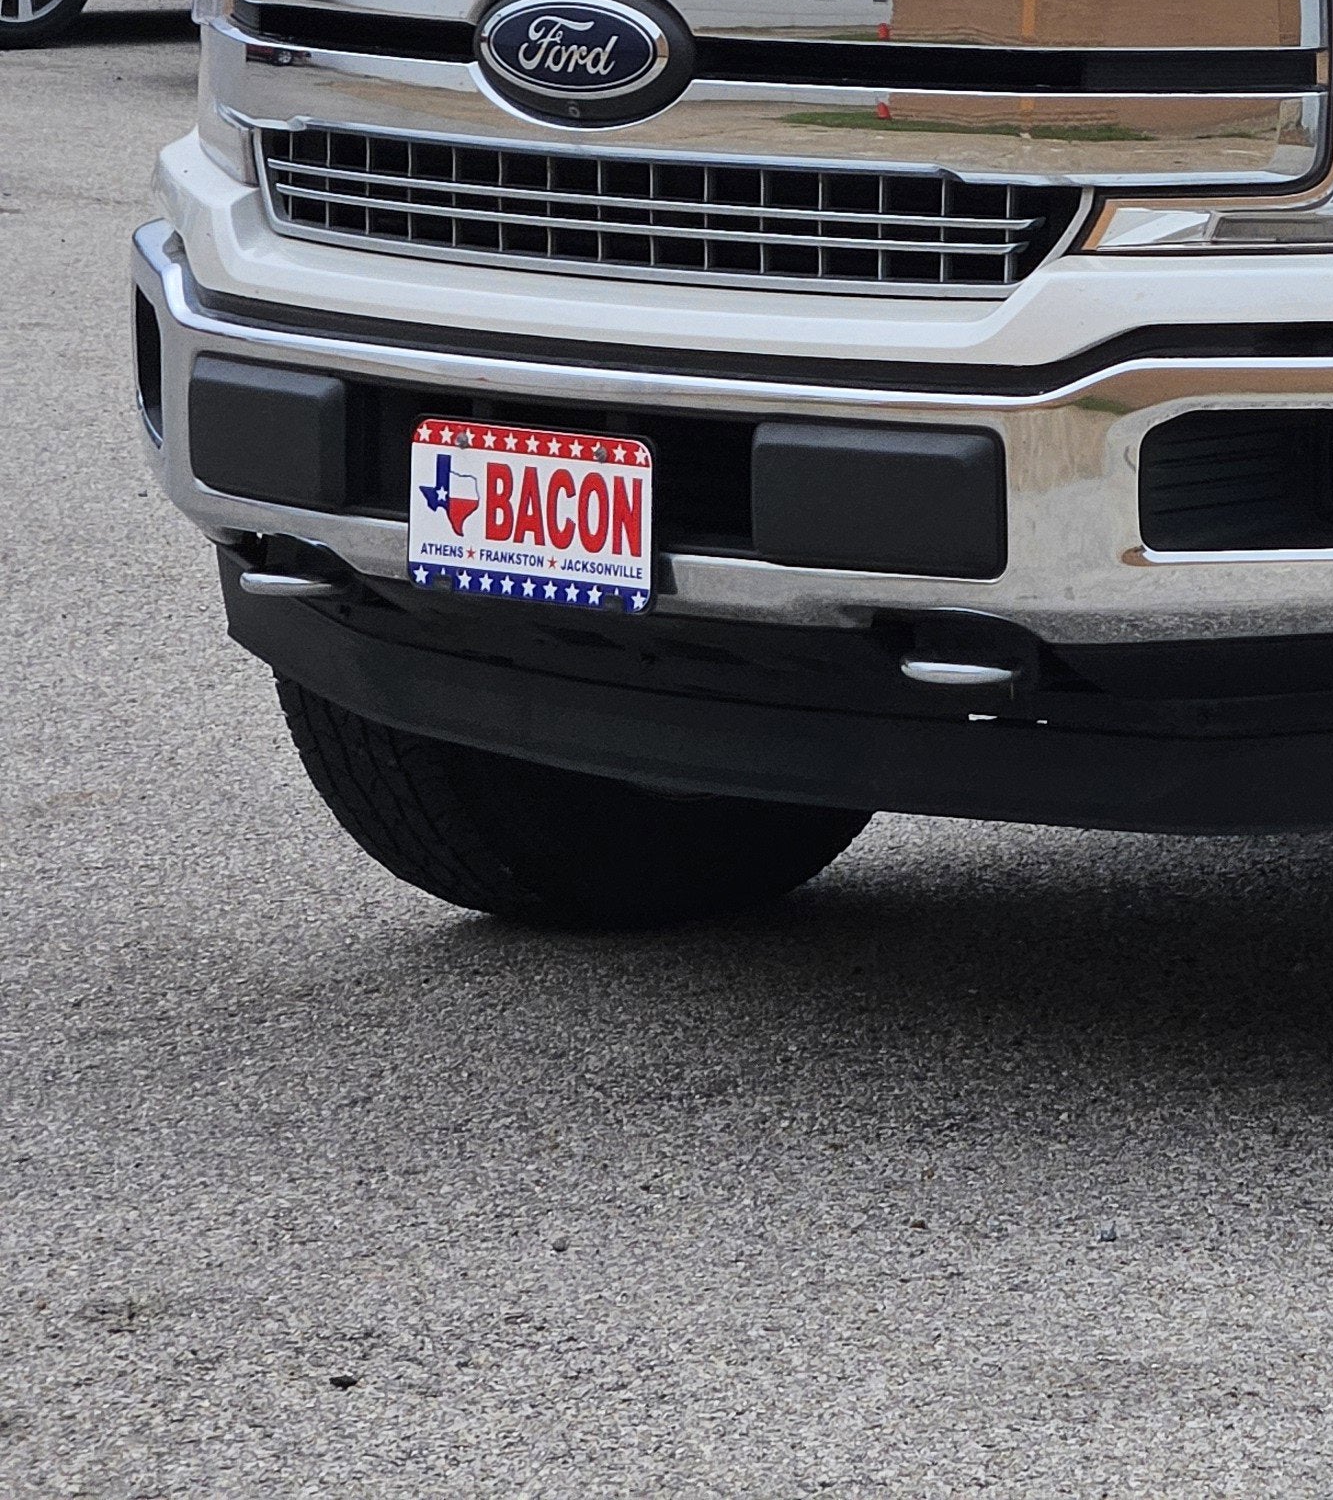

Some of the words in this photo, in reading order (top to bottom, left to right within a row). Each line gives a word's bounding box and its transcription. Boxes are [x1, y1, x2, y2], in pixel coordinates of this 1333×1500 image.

[517, 15, 619, 75] Ford
[485, 462, 643, 557] BACON
[420, 542, 464, 559] ATHENS
[479, 549, 545, 569] FRANKSTON
[560, 557, 643, 580] JACKSONVILLE
